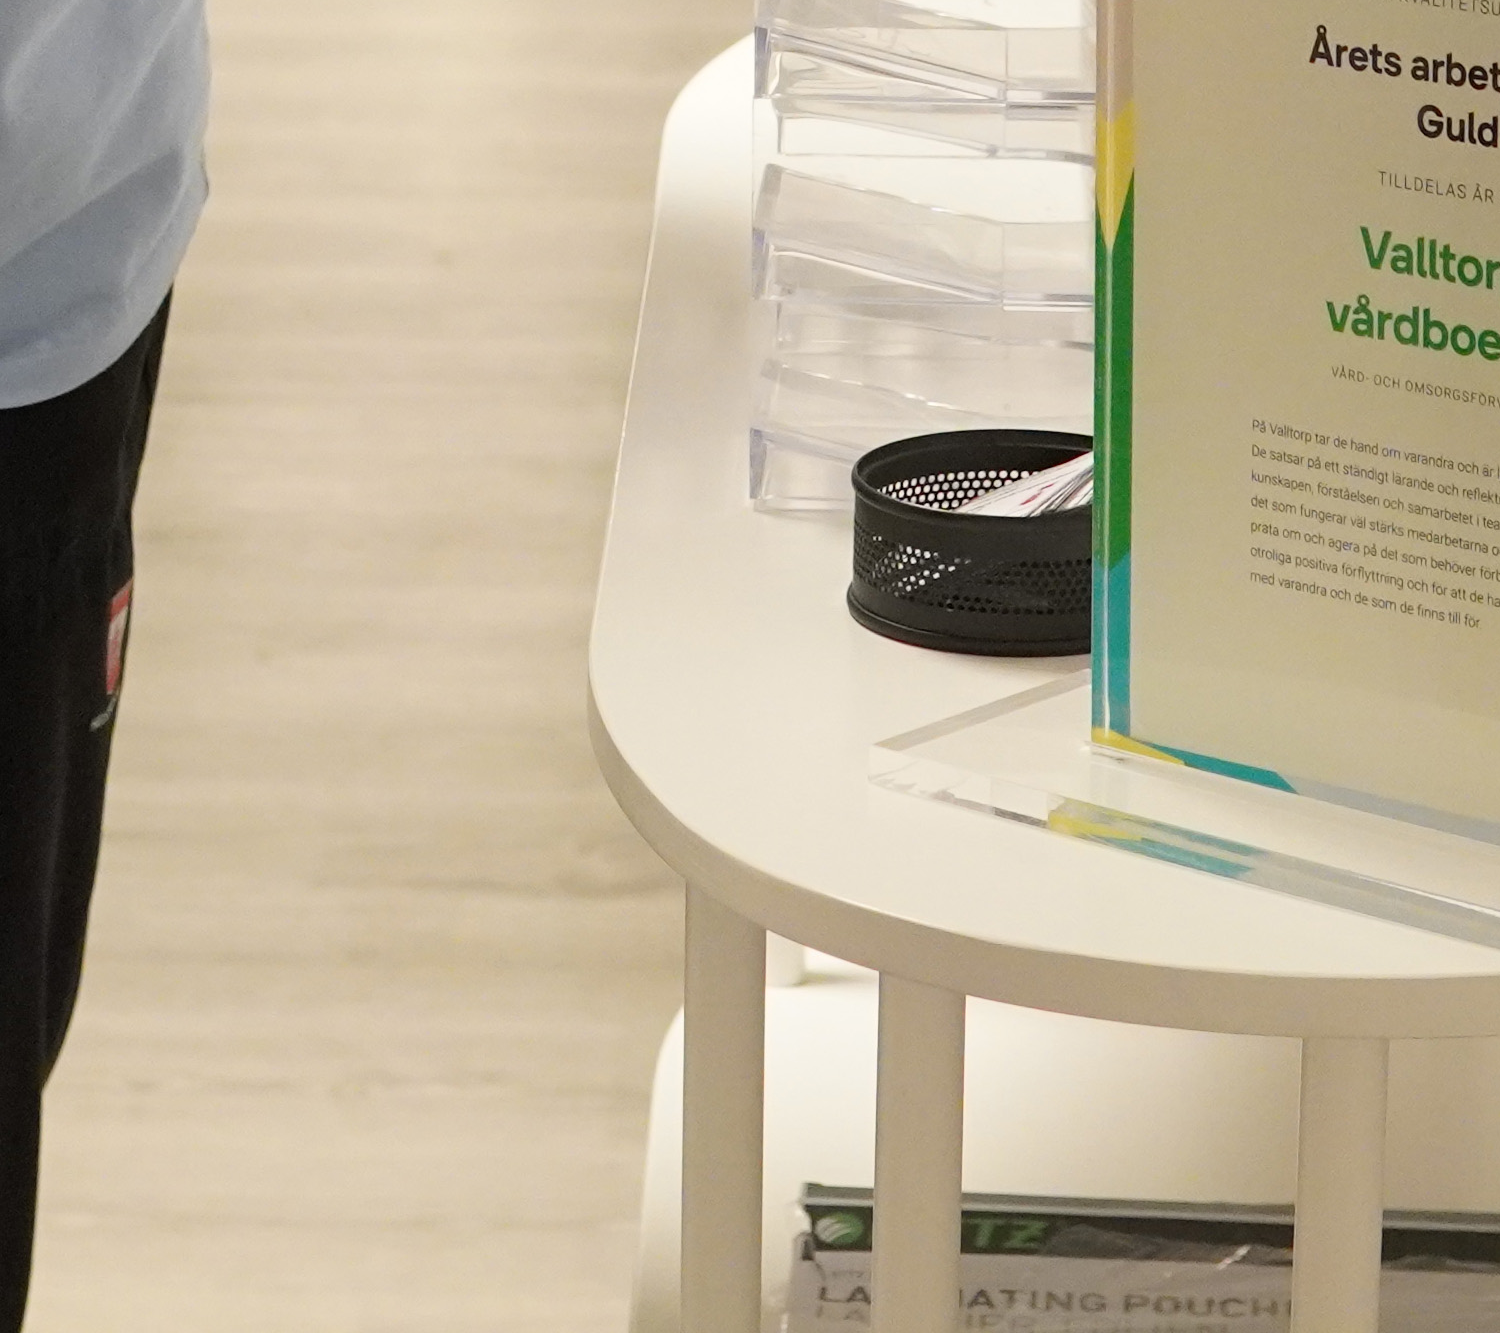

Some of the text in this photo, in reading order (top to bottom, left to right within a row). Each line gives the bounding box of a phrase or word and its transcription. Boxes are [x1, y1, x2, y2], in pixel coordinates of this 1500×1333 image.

[1309, 24, 1401, 77] Årets
[1417, 104, 1498, 148] Guld
[1378, 170, 1466, 199] TILLDELAS
[1472, 182, 1493, 203] ÅR
[1331, 364, 1368, 382] VÅRD-
[1373, 374, 1399, 388] OCH
[1251, 443, 1266, 458] De
[1269, 450, 1304, 465] satsar
[1307, 456, 1321, 469] på
[1324, 460, 1339, 473] ett
[1342, 464, 1388, 484] ständigt
[1392, 471, 1434, 492] lärande
[1437, 483, 1458, 496] och
[1252, 419, 1266, 433] På
[1269, 423, 1312, 444] Valltorp
[1314, 433, 1330, 444] tar
[1333, 436, 1347, 449] de
[1350, 438, 1378, 455] hand
[1381, 447, 1400, 459] om
[1404, 452, 1454, 470] varandra
[1457, 461, 1479, 475] och
[1481, 463, 1494, 477] är
[1250, 495, 1267, 509] det
[1271, 501, 1296, 513] som
[1300, 503, 1346, 524] fungerar
[1350, 517, 1365, 528] väl
[1369, 520, 1404, 536] stärks
[1407, 528, 1488, 553] medarbetarna
[1317, 481, 1379, 505] förståelsen
[1382, 498, 1404, 510] och
[1407, 502, 1473, 525] samarbetet
[1250, 521, 1279, 536] prata
[1282, 528, 1300, 540] om
[1303, 533, 1324, 545] och
[1328, 537, 1359, 553] agera
[1363, 543, 1377, 556] på
[1380, 546, 1397, 561] det
[1401, 552, 1427, 566] som
[1250, 547, 1291, 565] otroliga
[1295, 556, 1337, 573] positiva
[1406, 579, 1428, 592] och
[1431, 581, 1448, 597] för
[1450, 585, 1466, 601] att
[1469, 589, 1483, 604] de
[1250, 571, 1274, 585] med
[1278, 578, 1326, 596] varandra
[1329, 588, 1351, 601] och
[1354, 591, 1368, 605] de
[1371, 596, 1396, 611] som
[1399, 600, 1414, 615] de
[1416, 603, 1445, 621] finns
[1448, 611, 1460, 624] till
[817, 1285, 1107, 1313] LAATING
